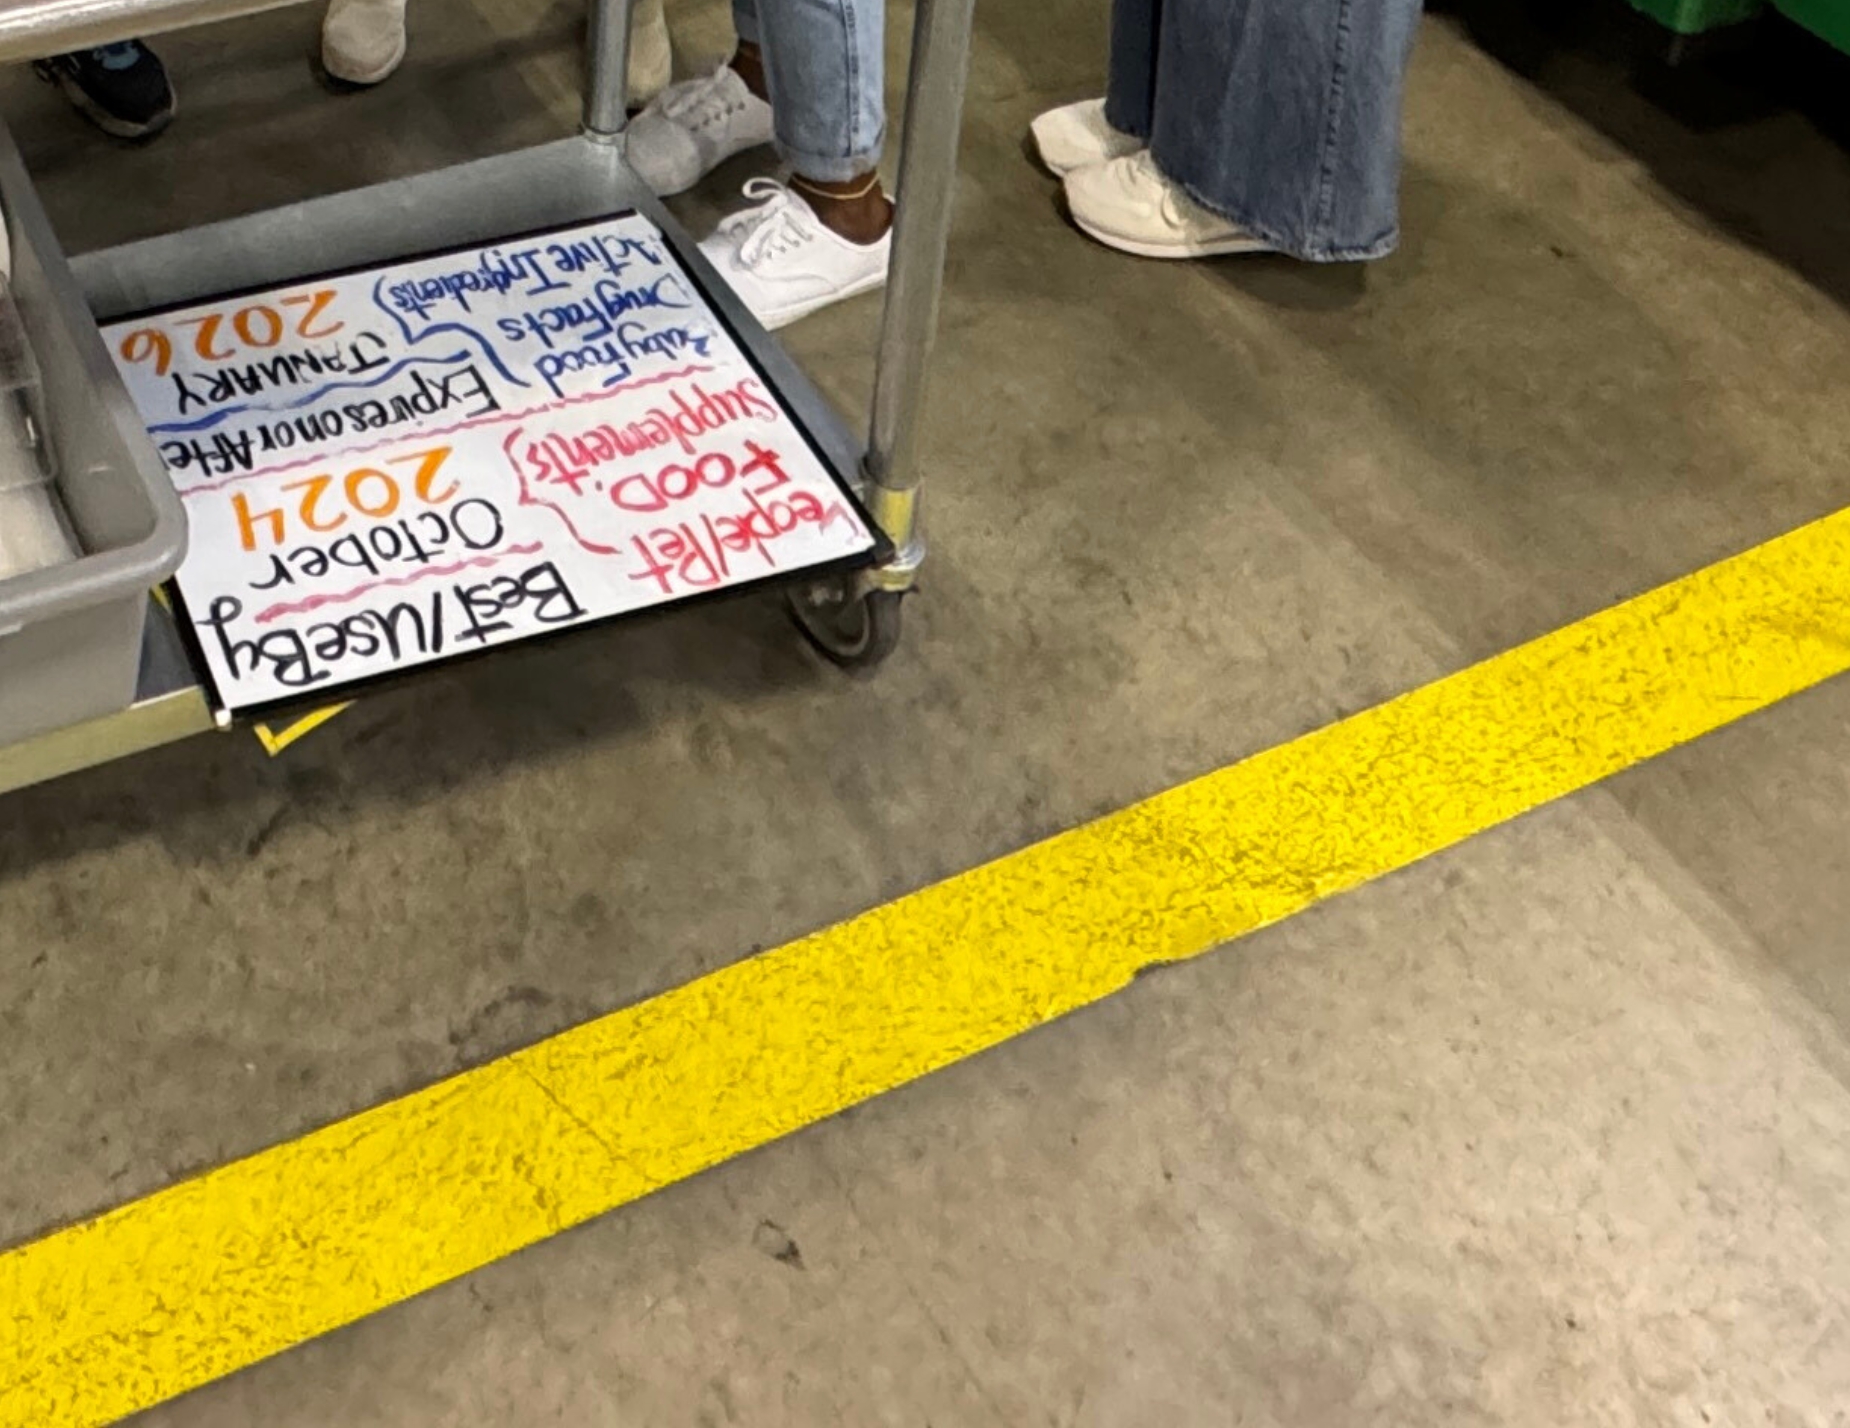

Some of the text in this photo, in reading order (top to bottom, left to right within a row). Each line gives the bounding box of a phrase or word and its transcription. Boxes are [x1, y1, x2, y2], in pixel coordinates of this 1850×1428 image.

[388, 234, 663, 322] Active Ingredients
[120, 289, 346, 377] 2026
[173, 330, 391, 414] JANUARY
[526, 378, 778, 496] Supplements
[230, 445, 462, 552] 2024
[249, 497, 505, 591] October
